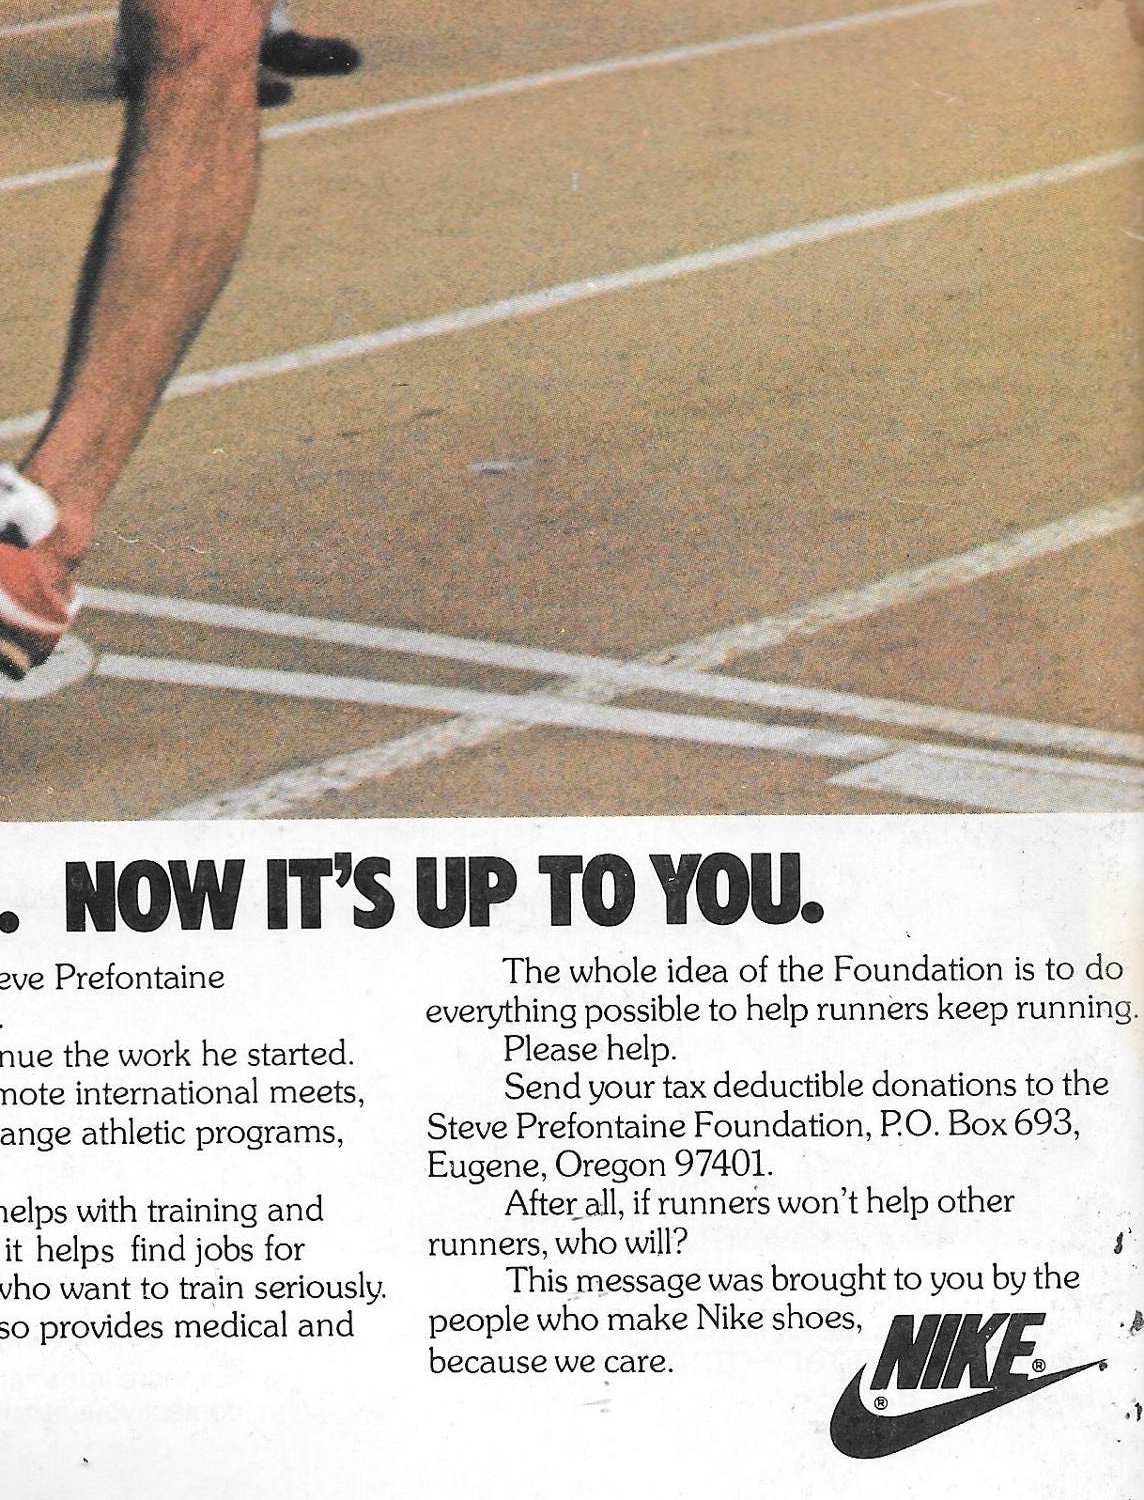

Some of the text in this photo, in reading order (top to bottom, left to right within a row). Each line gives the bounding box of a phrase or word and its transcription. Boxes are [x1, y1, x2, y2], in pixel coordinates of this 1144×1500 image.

[65, 858, 246, 933] NOW
[266, 851, 396, 930] IT'S
[415, 855, 518, 930] UP
[538, 853, 636, 928] TO
[648, 851, 825, 926] YOU.
[54, 962, 225, 990] Prefontaine
[501, 952, 1124, 984] The whole idea of the Foundation is to do
[425, 991, 1140, 1030] everything possible to help runners keep running.
[63, 1039, 110, 1068] the
[118, 1039, 192, 1067] work
[201, 1038, 238, 1067] he
[247, 1038, 354, 1067] started.
[503, 1033, 677, 1068] Please help.
[75, 1076, 258, 1106] international
[269, 1080, 365, 1108] meets,
[504, 1068, 1109, 1106] Send your tax deductible donations to the
[81, 1117, 186, 1146] athletic
[195, 1125, 343, 1152] programs,
[427, 1107, 1080, 1142] Steve Prefontaine Foundation, P.O. Box 693,
[427, 1148, 773, 1185] Eugene, Oregon 97401.
[76, 1195, 138, 1223] with
[146, 1197, 258, 1229] training
[267, 1193, 324, 1222] and
[428, 1226, 688, 1260] runners, who will?
[59, 1276, 132, 1301] want
[140, 1276, 169, 1300] to
[178, 1274, 244, 1300] train
[254, 1270, 386, 1306] seriously.
[428, 1302, 864, 1340] people who make Nike shoes,
[428, 1346, 675, 1375] because we care.
